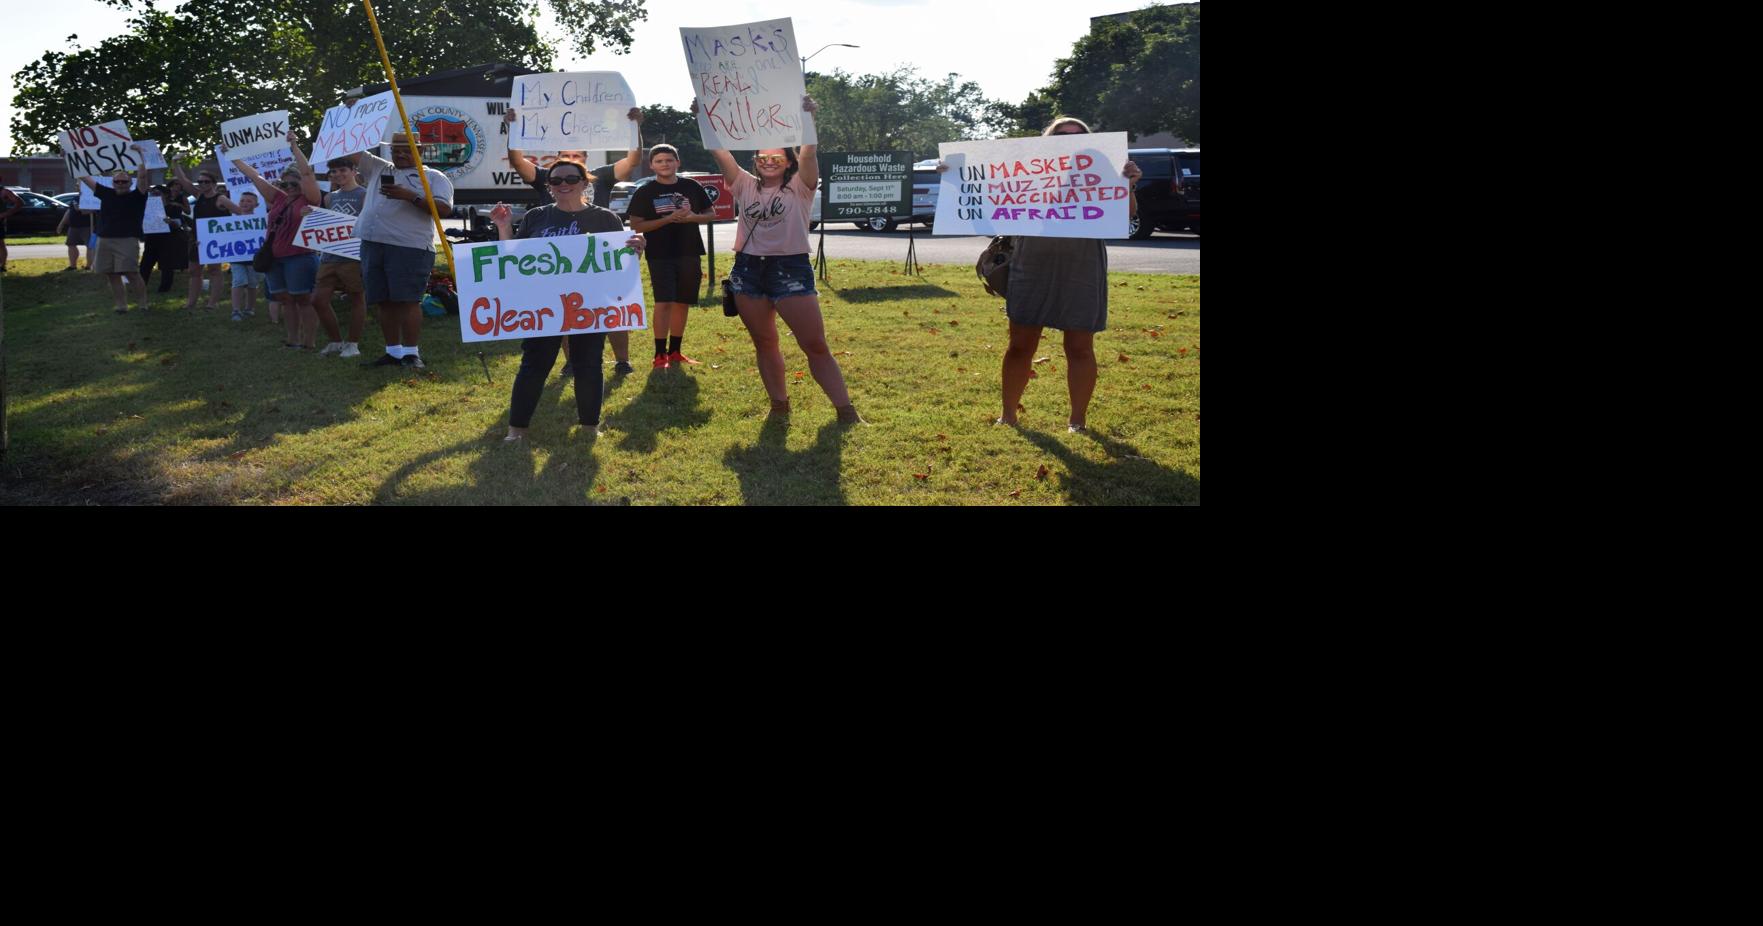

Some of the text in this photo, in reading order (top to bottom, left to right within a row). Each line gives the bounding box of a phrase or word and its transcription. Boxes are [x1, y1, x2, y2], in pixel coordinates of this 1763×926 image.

[685, 27, 788, 64] MASKS
[521, 80, 624, 109] My Children
[700, 72, 751, 96] REAL
[323, 106, 352, 132] NO
[521, 112, 549, 141] My
[67, 127, 99, 150] NO
[223, 120, 286, 149] UNMASK
[311, 115, 391, 162] MASKS
[67, 141, 137, 179] MASK
[832, 163, 906, 173] Hazardous Waste
[847, 153, 892, 164] Household
[959, 154, 1094, 182] UN MASKED
[829, 174, 882, 182] Collection
[960, 182, 982, 194] UN
[958, 185, 1129, 206] UN VACCINATED
[837, 206, 897, 215] 790-5848
[957, 205, 1105, 221] UN AFRAID
[471, 235, 636, 283] Fresh Air
[469, 291, 644, 336] Clear Brain
